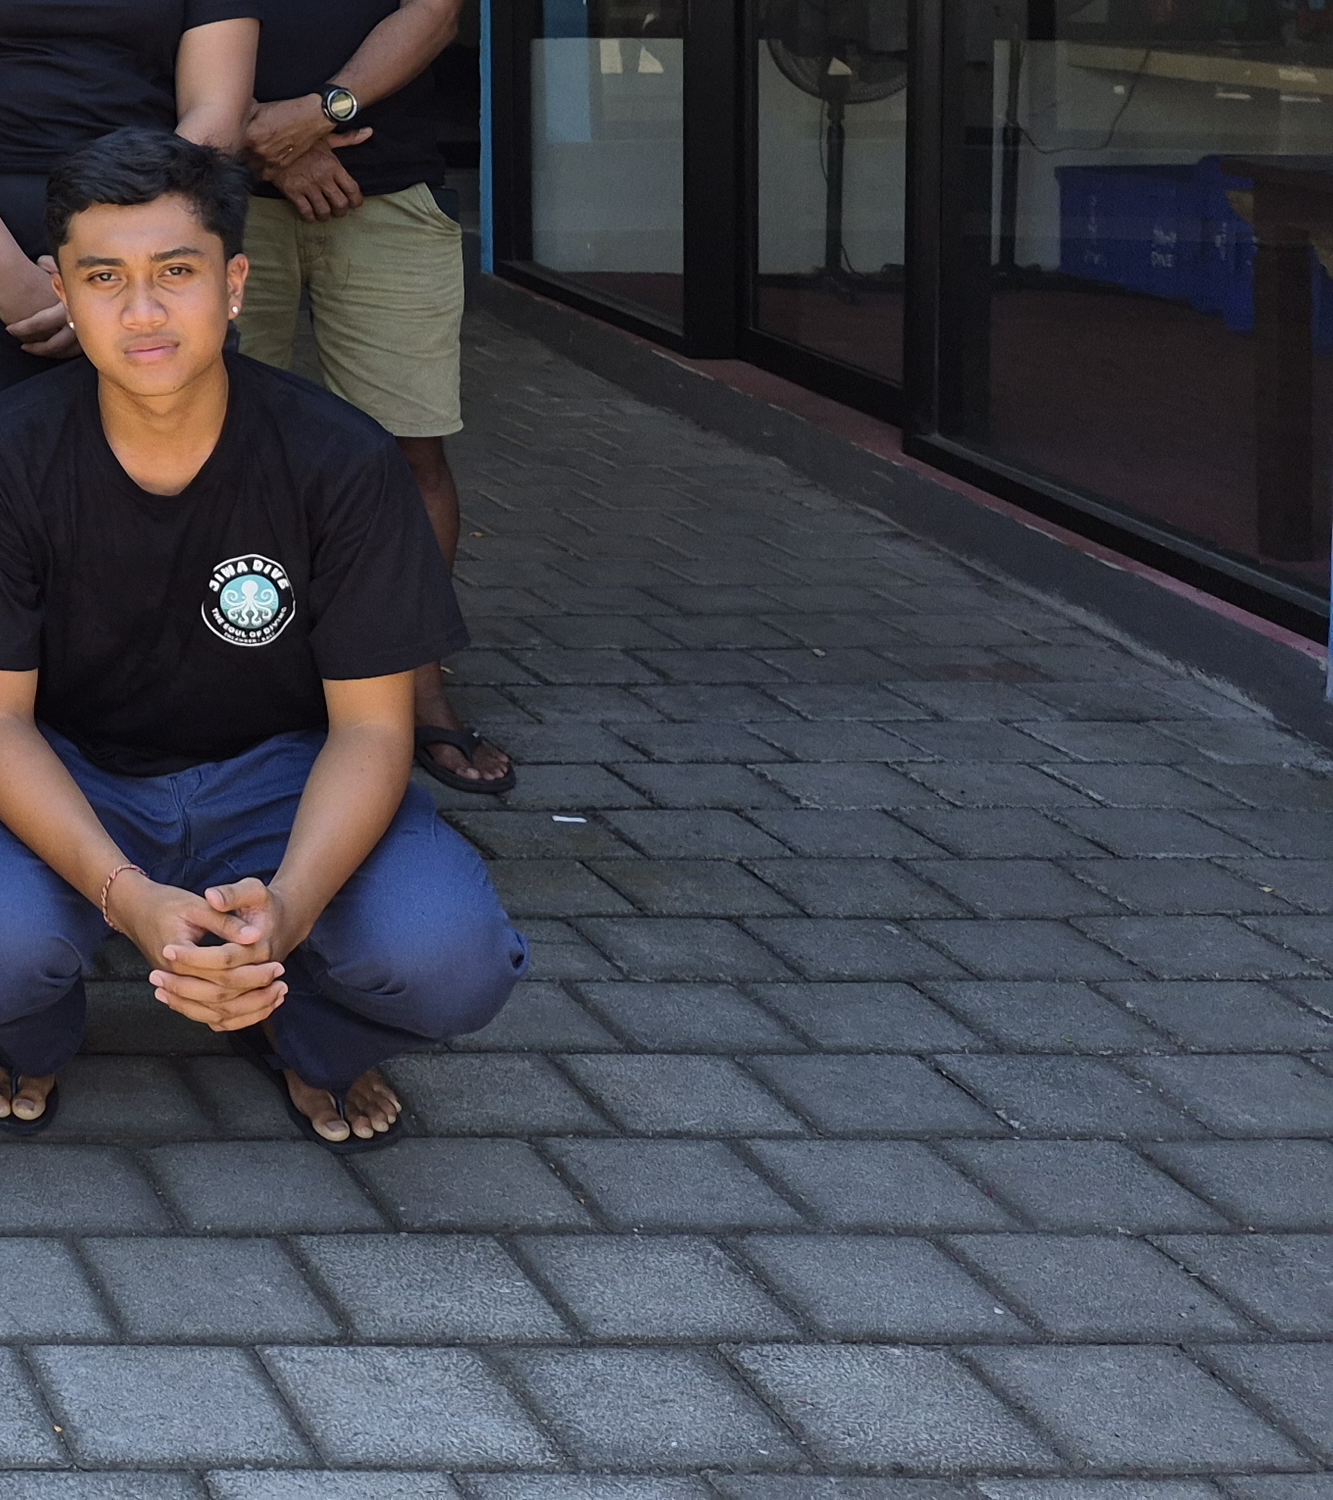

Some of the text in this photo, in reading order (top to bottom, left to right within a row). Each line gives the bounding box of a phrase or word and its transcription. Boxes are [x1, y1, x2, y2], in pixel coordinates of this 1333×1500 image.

[208, 559, 290, 592] JIWA DIVE
[211, 607, 225, 625] THE
[222, 623, 247, 638] SOUL
[263, 606, 288, 635] DIVING
